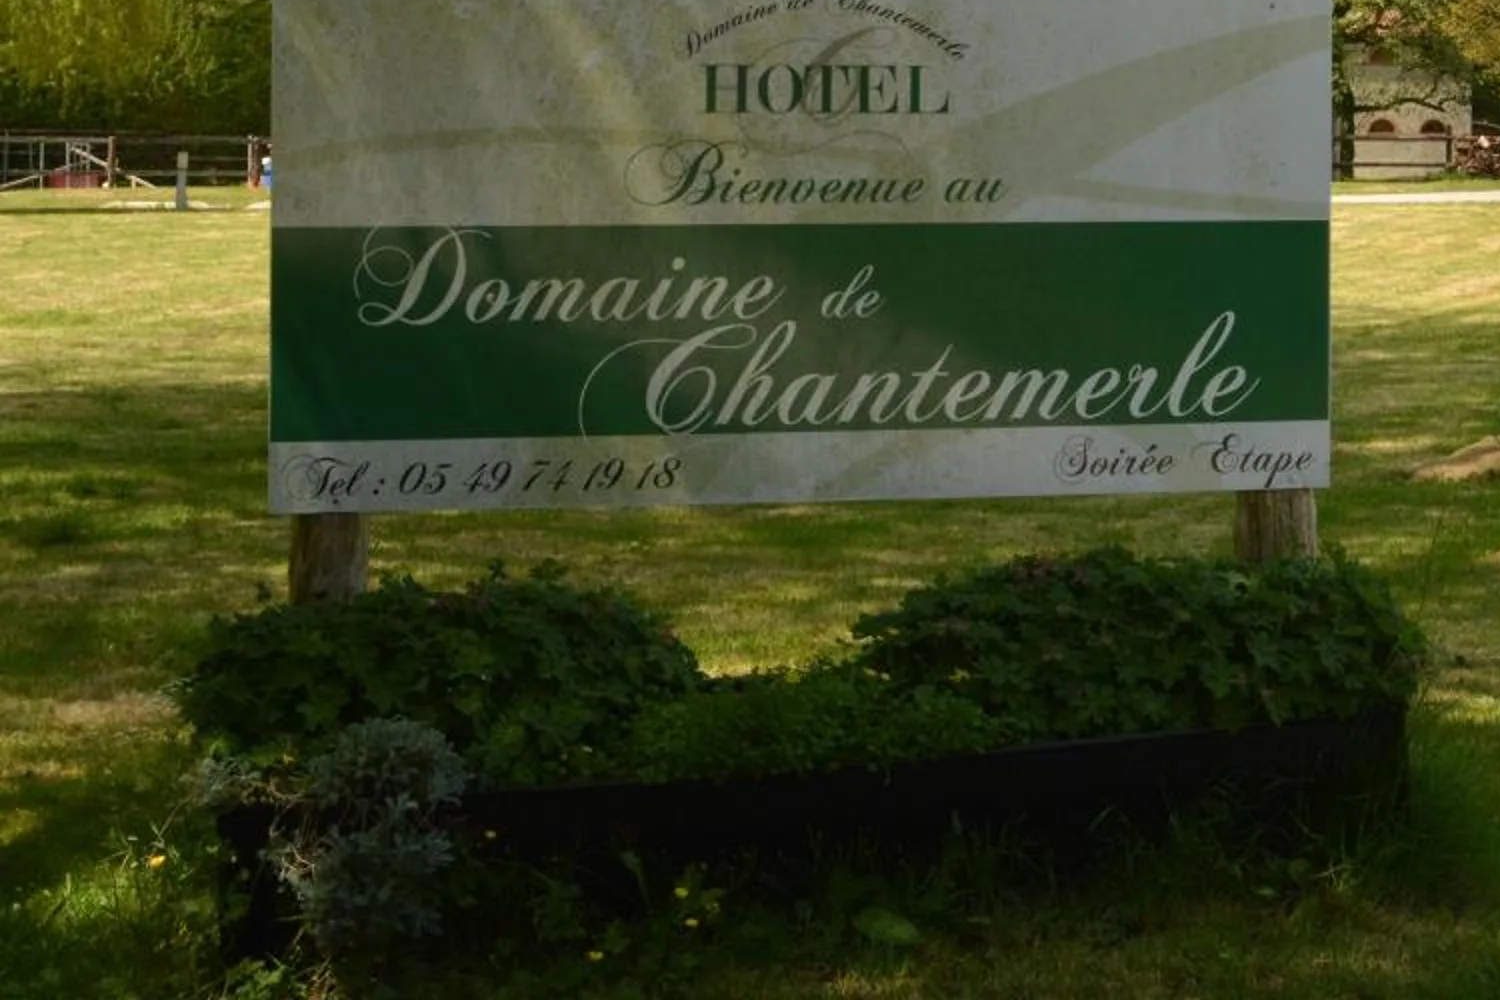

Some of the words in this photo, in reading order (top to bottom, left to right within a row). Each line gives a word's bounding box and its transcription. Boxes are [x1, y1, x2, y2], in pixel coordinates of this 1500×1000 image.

[676, 1, 779, 58] Domaine
[704, 64, 950, 114] HOTEL
[624, 139, 925, 206] Bienvenue
[945, 176, 1007, 202] au
[354, 220, 786, 326] Domaine
[820, 265, 884, 319] de
[578, 310, 1262, 440] Chantemerle
[399, 461, 452, 495] 05
[462, 460, 512, 494] 49
[521, 460, 572, 493] 74
[581, 458, 625, 491] 19
[635, 456, 684, 490] 18
[1054, 433, 1176, 483] Soirée
[1190, 433, 1314, 488] Etape
